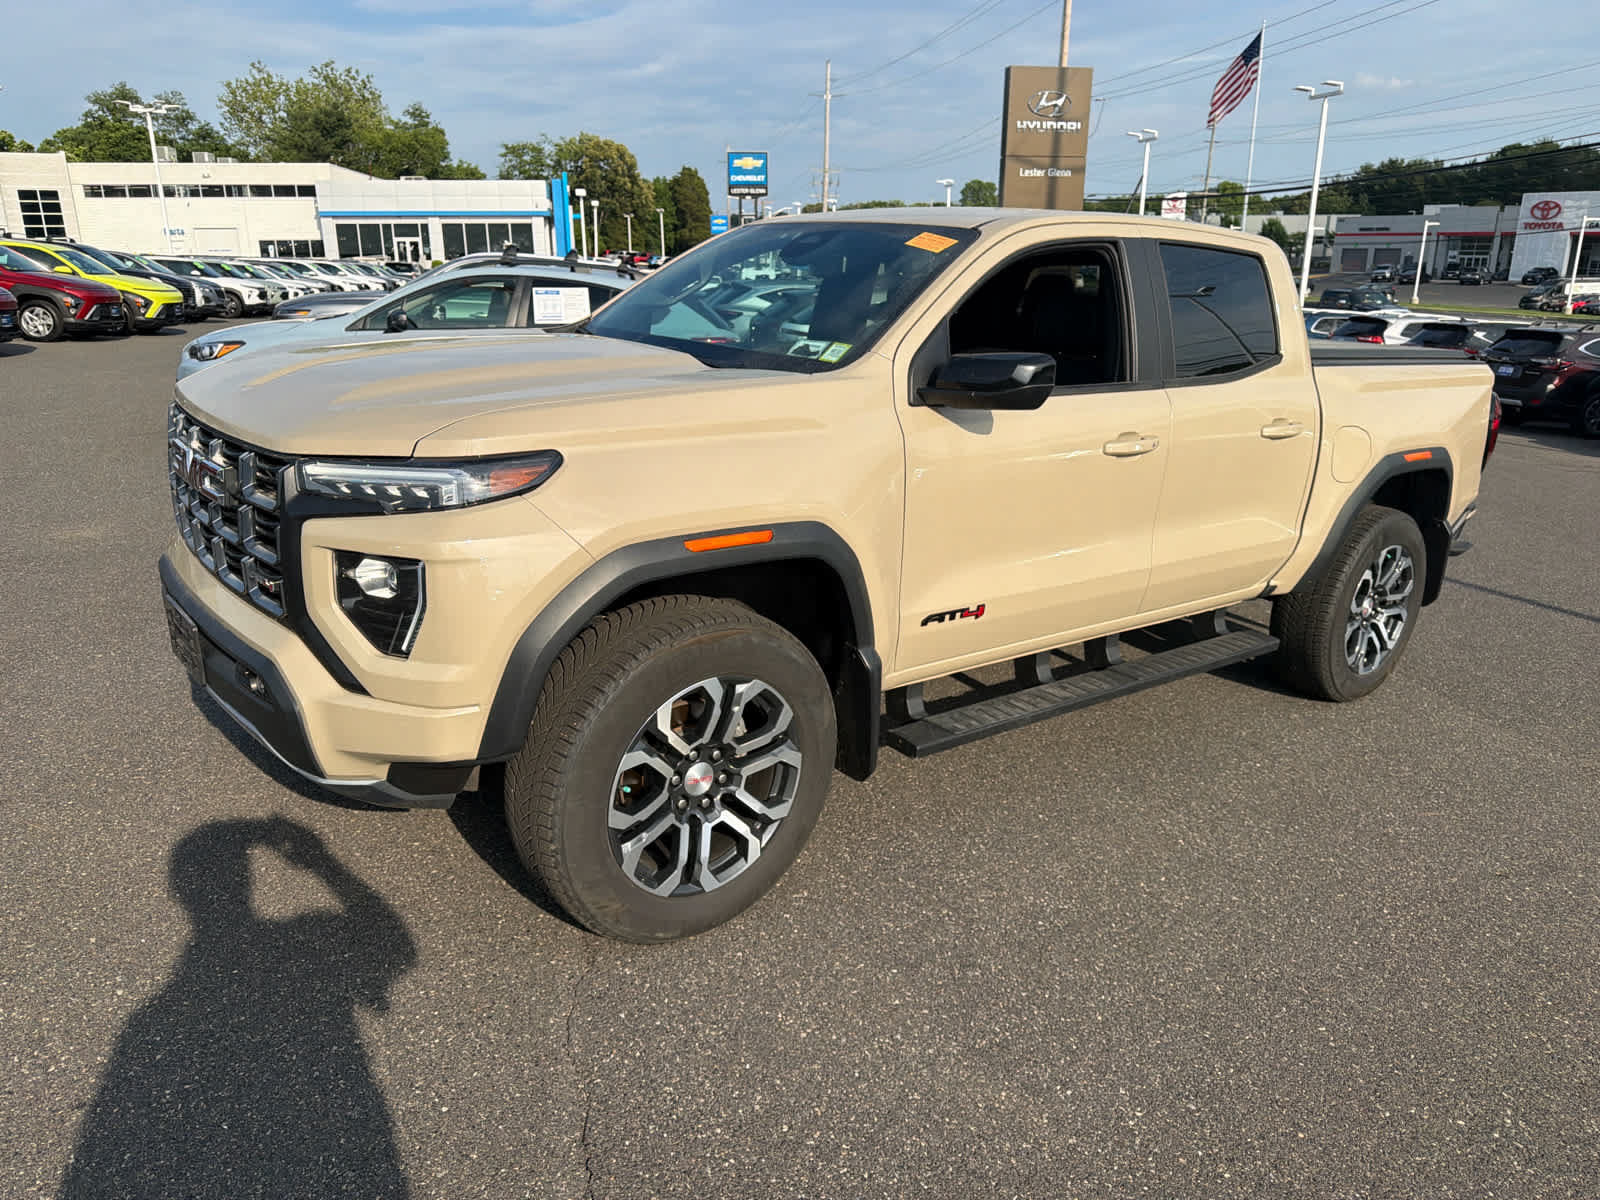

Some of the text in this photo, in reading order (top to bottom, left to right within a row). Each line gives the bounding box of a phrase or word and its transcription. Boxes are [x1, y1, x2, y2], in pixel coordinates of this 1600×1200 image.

[1019, 167, 1072, 177] Lester Glenn
[1523, 221, 1565, 231] TOYOTA
[920, 603, 986, 627] AT4
